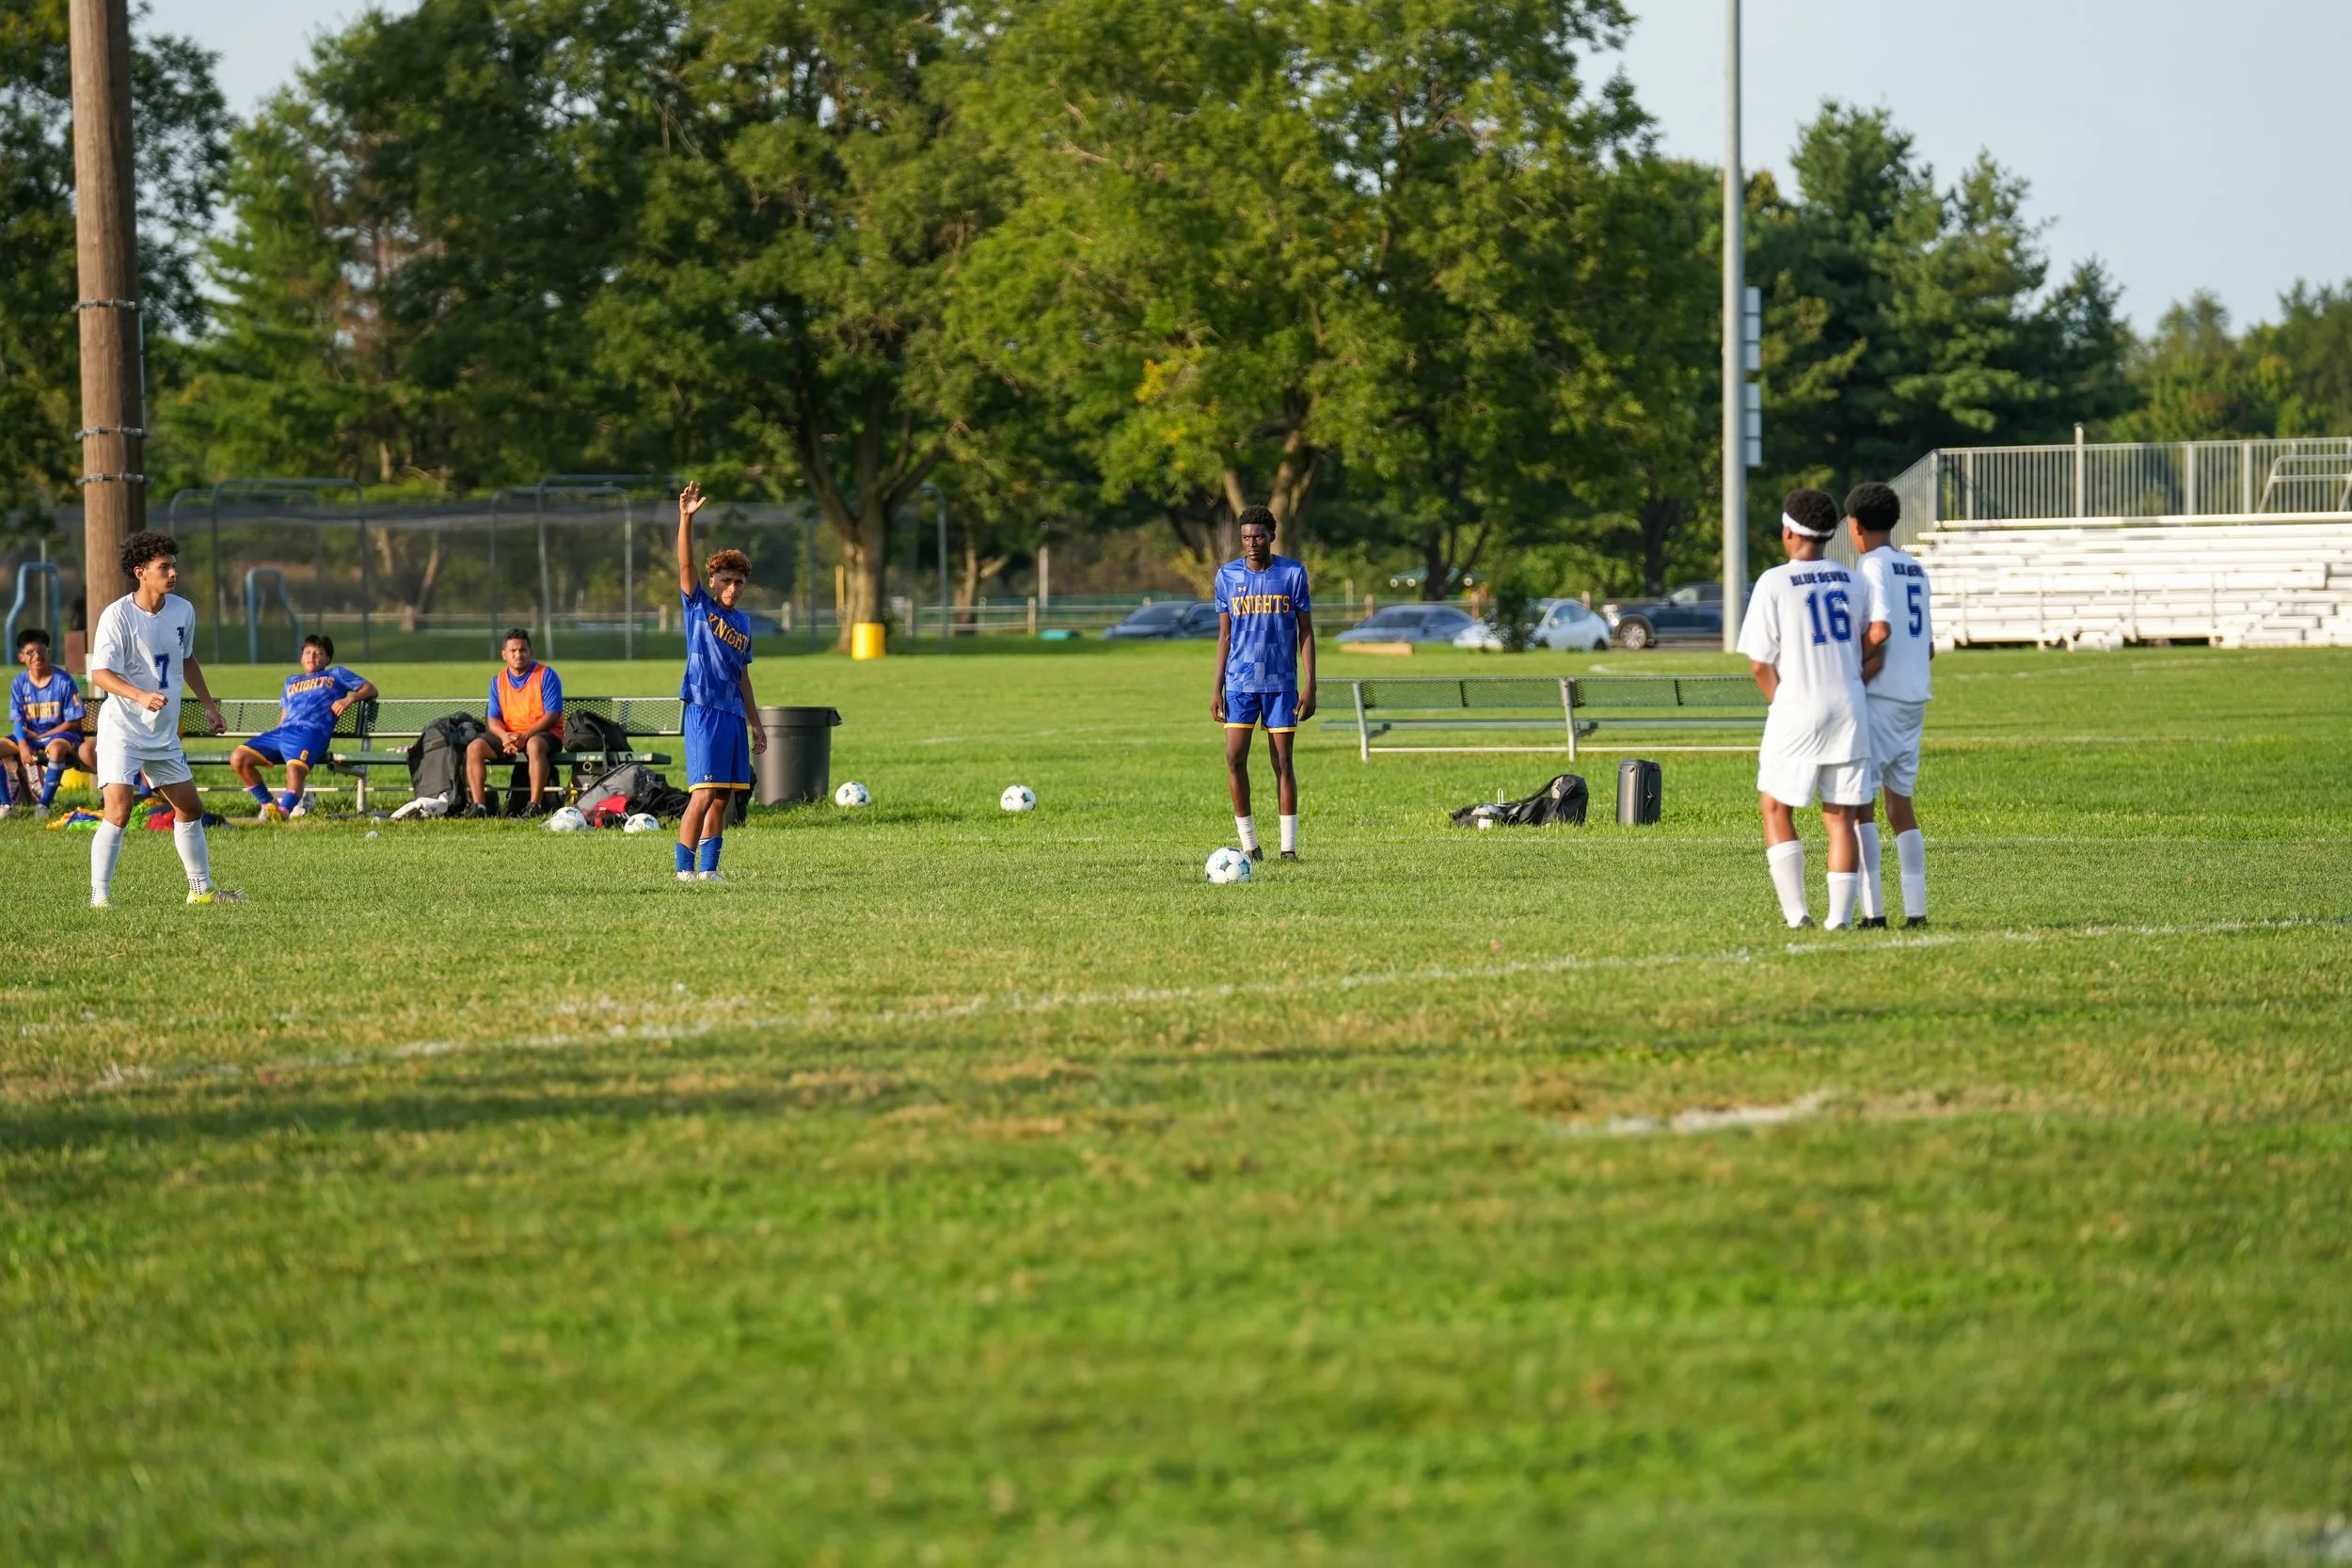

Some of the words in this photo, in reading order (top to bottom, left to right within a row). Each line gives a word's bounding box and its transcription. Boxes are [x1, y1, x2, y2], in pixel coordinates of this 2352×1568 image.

[1790, 572, 1818, 587] BLUE
[1231, 594, 1291, 616] KNIGHTS
[1804, 589, 1851, 647] 16
[1906, 582, 1923, 638] 5
[153, 652, 170, 690] 7
